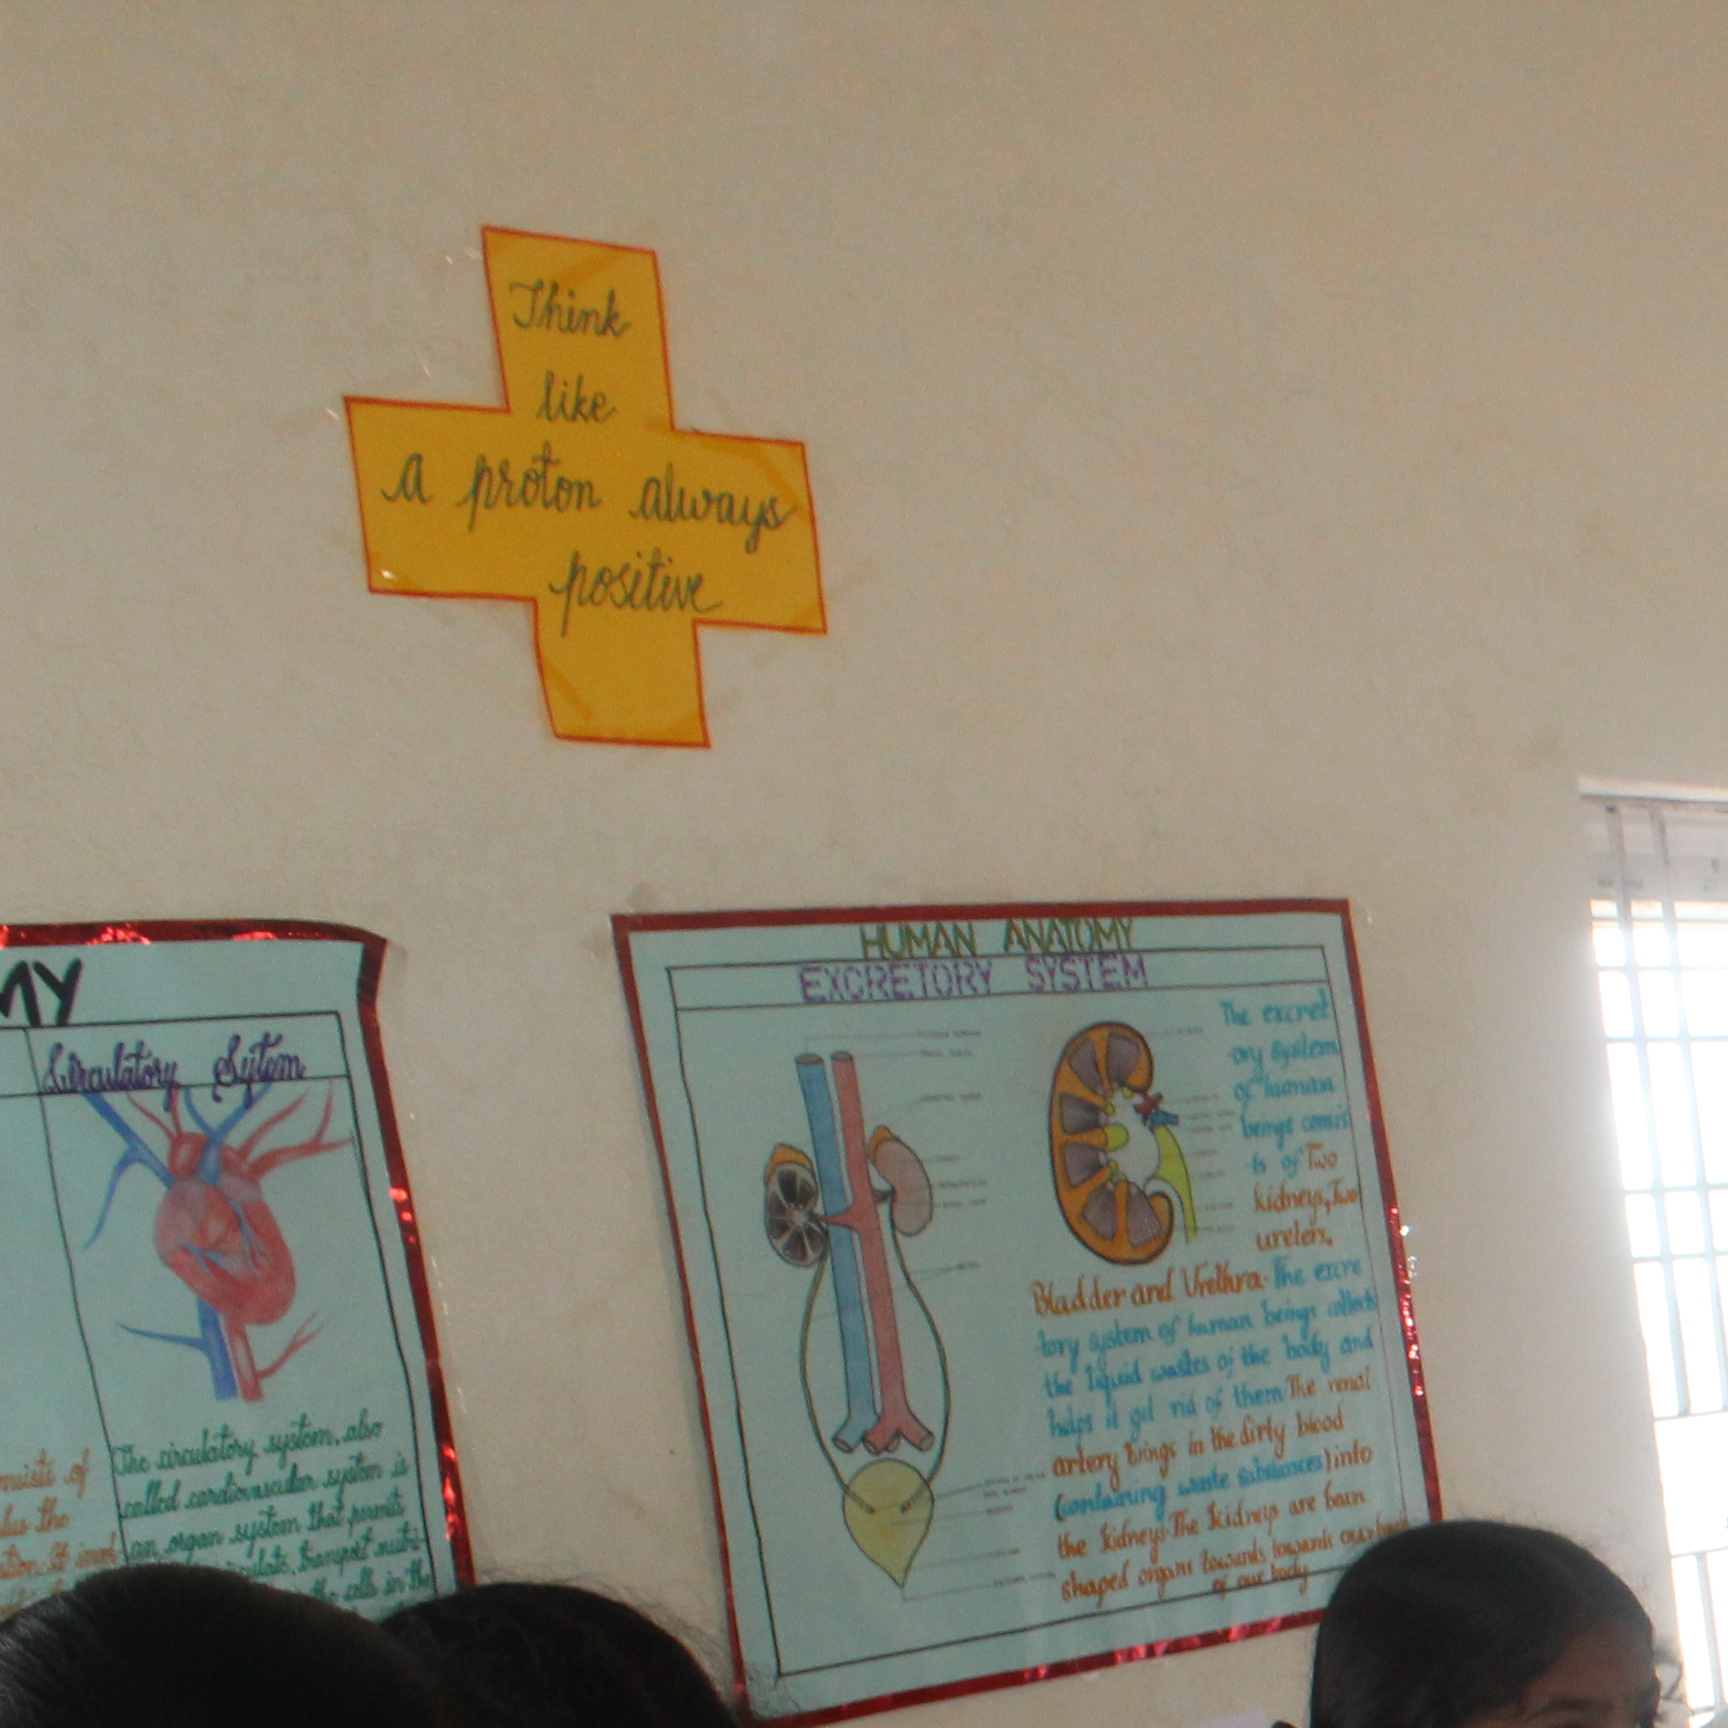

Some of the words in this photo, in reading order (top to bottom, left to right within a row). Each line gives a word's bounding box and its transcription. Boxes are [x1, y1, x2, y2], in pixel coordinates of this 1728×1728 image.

[509, 280, 632, 338] Think
[535, 371, 617, 423] like
[381, 453, 432, 502] a
[456, 441, 602, 532] proton
[628, 462, 796, 554] always
[548, 547, 724, 638] positive
[858, 921, 979, 960] HUMAN
[1003, 916, 1134, 955] ANATOMY
[799, 960, 992, 1003] EXCRETORY
[1024, 951, 1150, 995] SYSTEM
[1219, 999, 1250, 1027] The
[1305, 1142, 1340, 1171] Two
[1029, 1274, 1127, 1317] Bladder
[1130, 1267, 1176, 1307] and
